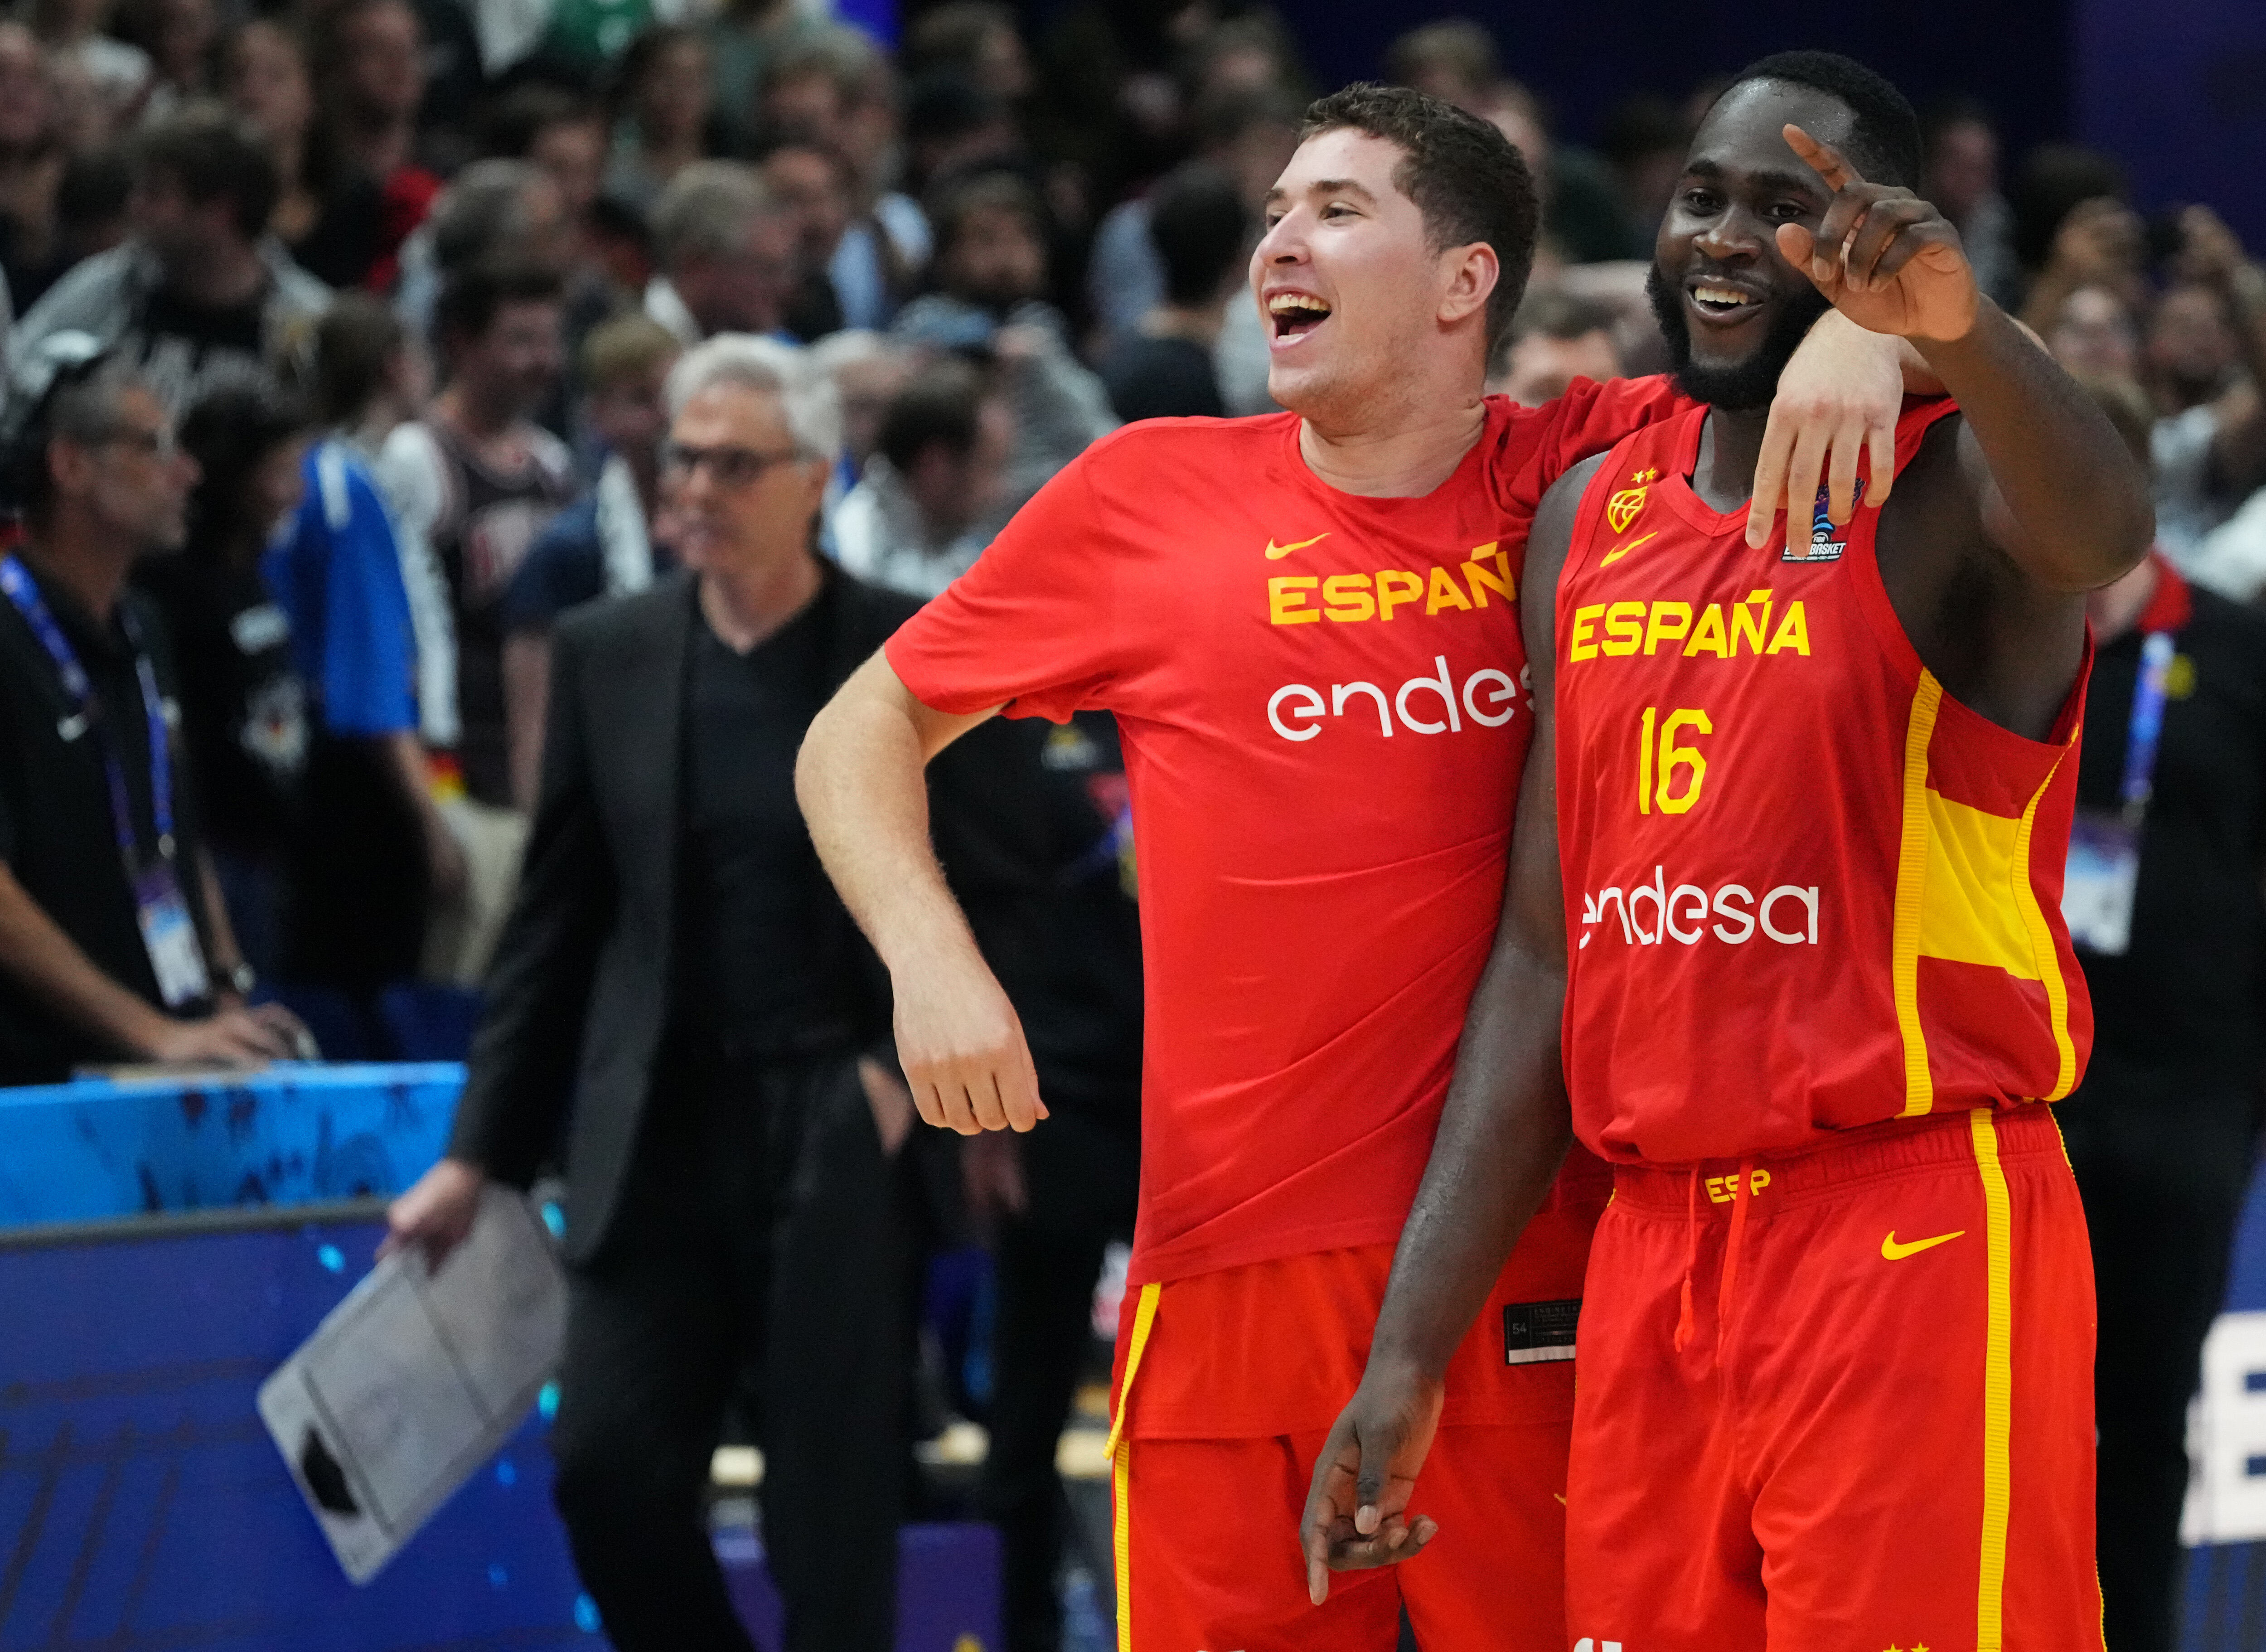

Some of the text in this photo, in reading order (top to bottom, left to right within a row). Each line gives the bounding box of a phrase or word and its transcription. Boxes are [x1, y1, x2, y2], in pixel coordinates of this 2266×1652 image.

[1268, 541, 1516, 625] ESPAÑ
[1570, 588, 1811, 663] ESPAÑA
[1639, 707, 1713, 814] 16
